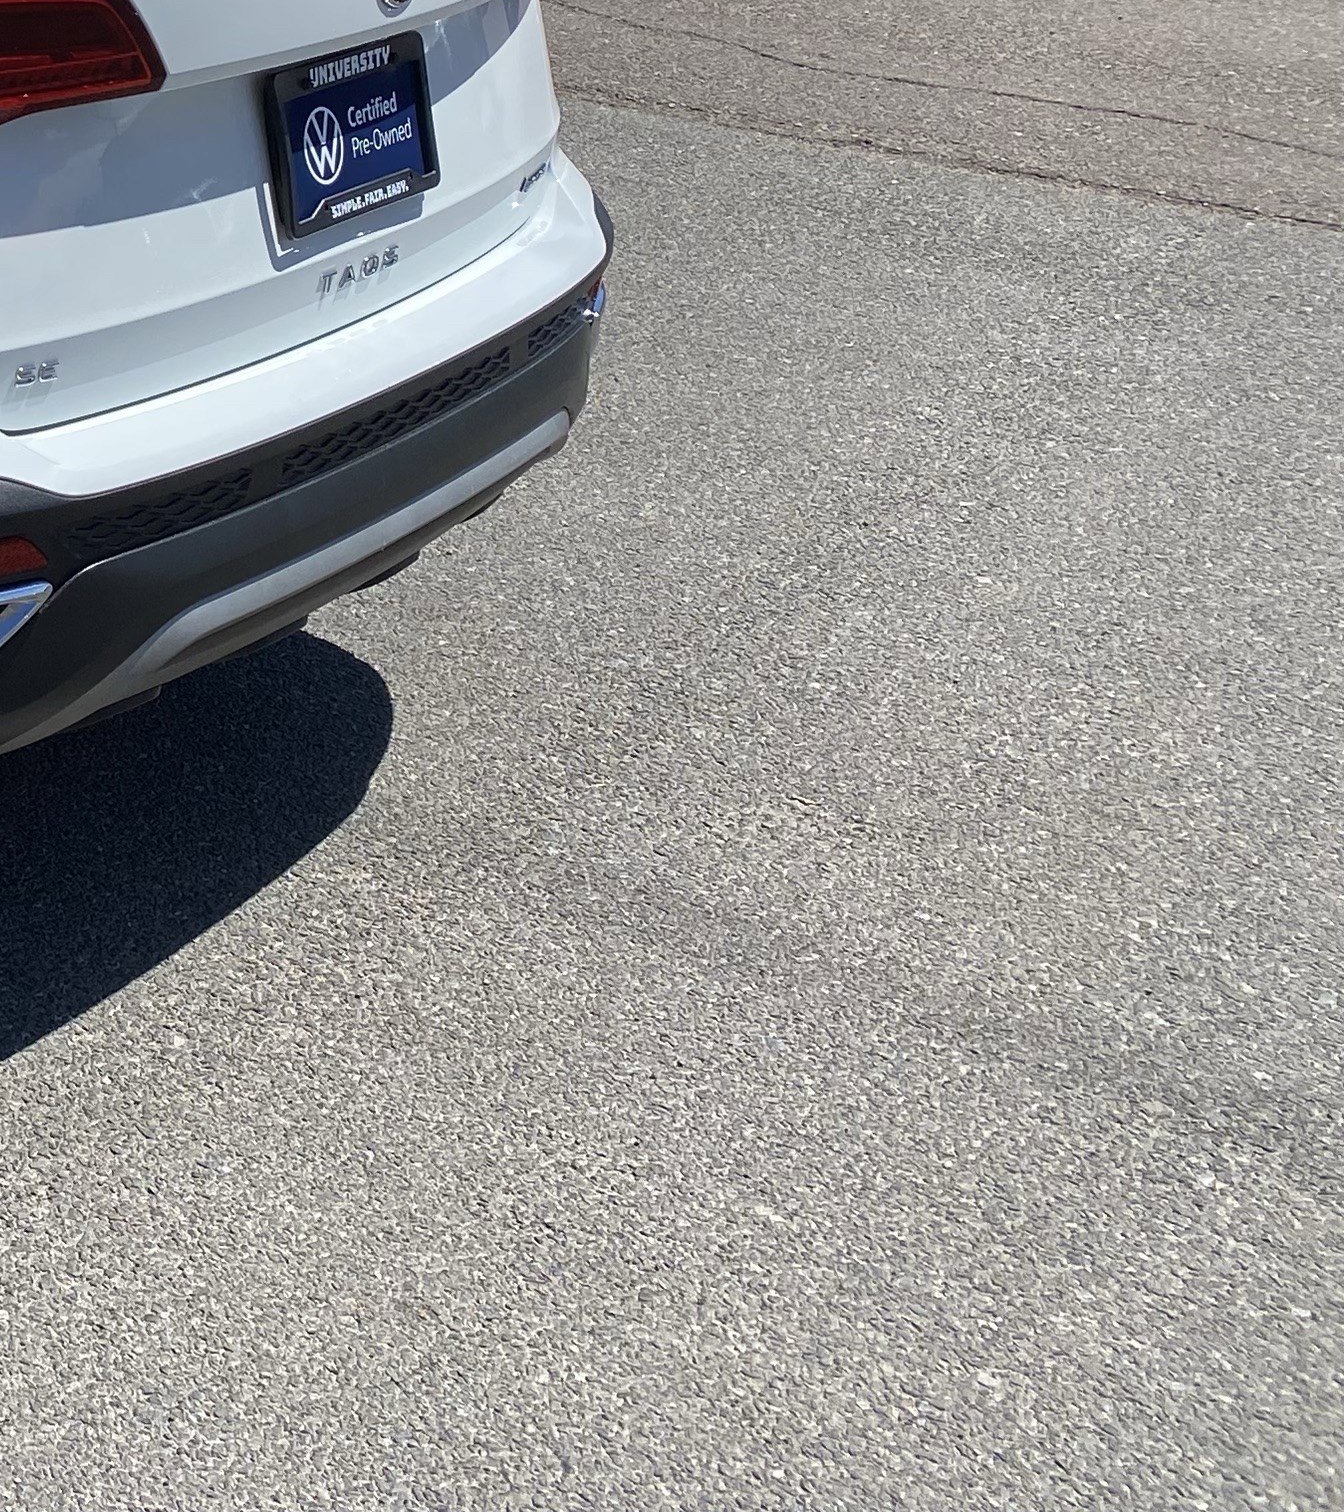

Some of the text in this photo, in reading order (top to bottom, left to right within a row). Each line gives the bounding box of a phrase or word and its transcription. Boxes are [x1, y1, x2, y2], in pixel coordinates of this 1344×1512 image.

[309, 44, 391, 88] UNIVERSITY
[347, 91, 398, 128] Certified
[351, 117, 412, 159] Pre-Owned
[320, 244, 400, 295] TAOS
[14, 359, 60, 389] SE
